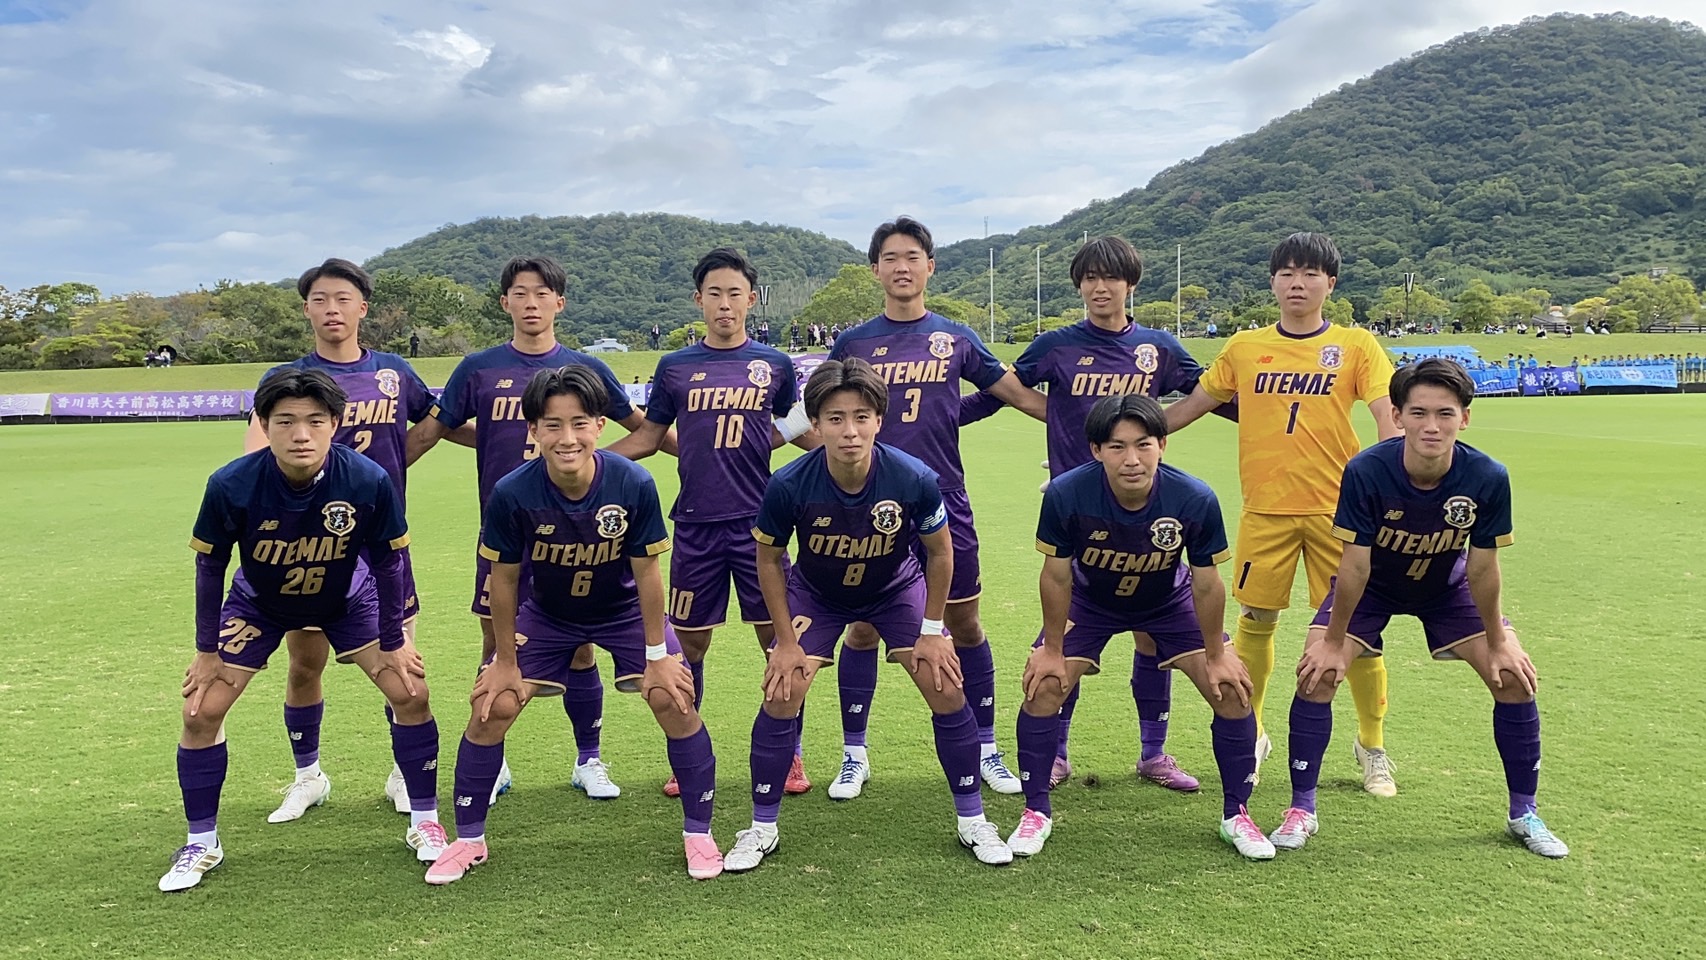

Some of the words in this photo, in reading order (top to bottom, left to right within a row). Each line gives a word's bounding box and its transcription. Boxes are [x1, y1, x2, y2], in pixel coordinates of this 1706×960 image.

[1071, 373, 1153, 397] OTEMAE
[1254, 372, 1337, 395] OTEMAE
[341, 399, 398, 427] EMAE
[687, 387, 768, 412] OTEMAE
[902, 388, 921, 423] 3
[714, 414, 744, 449] 10
[1286, 402, 1300, 435] 1
[354, 430, 372, 453] 2
[523, 431, 540, 460] 5
[252, 536, 350, 565] OTEMAE
[531, 538, 624, 567] OTEMAE
[809, 533, 896, 559] OTEMAE
[1376, 526, 1470, 555] OTEMAE
[1081, 546, 1177, 573] OTEMAE
[1407, 558, 1431, 581] 4
[280, 566, 327, 595] 26
[570, 570, 593, 597] 6
[842, 563, 866, 586] 8
[1115, 575, 1140, 597] 9
[1238, 561, 1252, 589] 1
[670, 587, 694, 621] 10
[219, 617, 262, 655] 26
